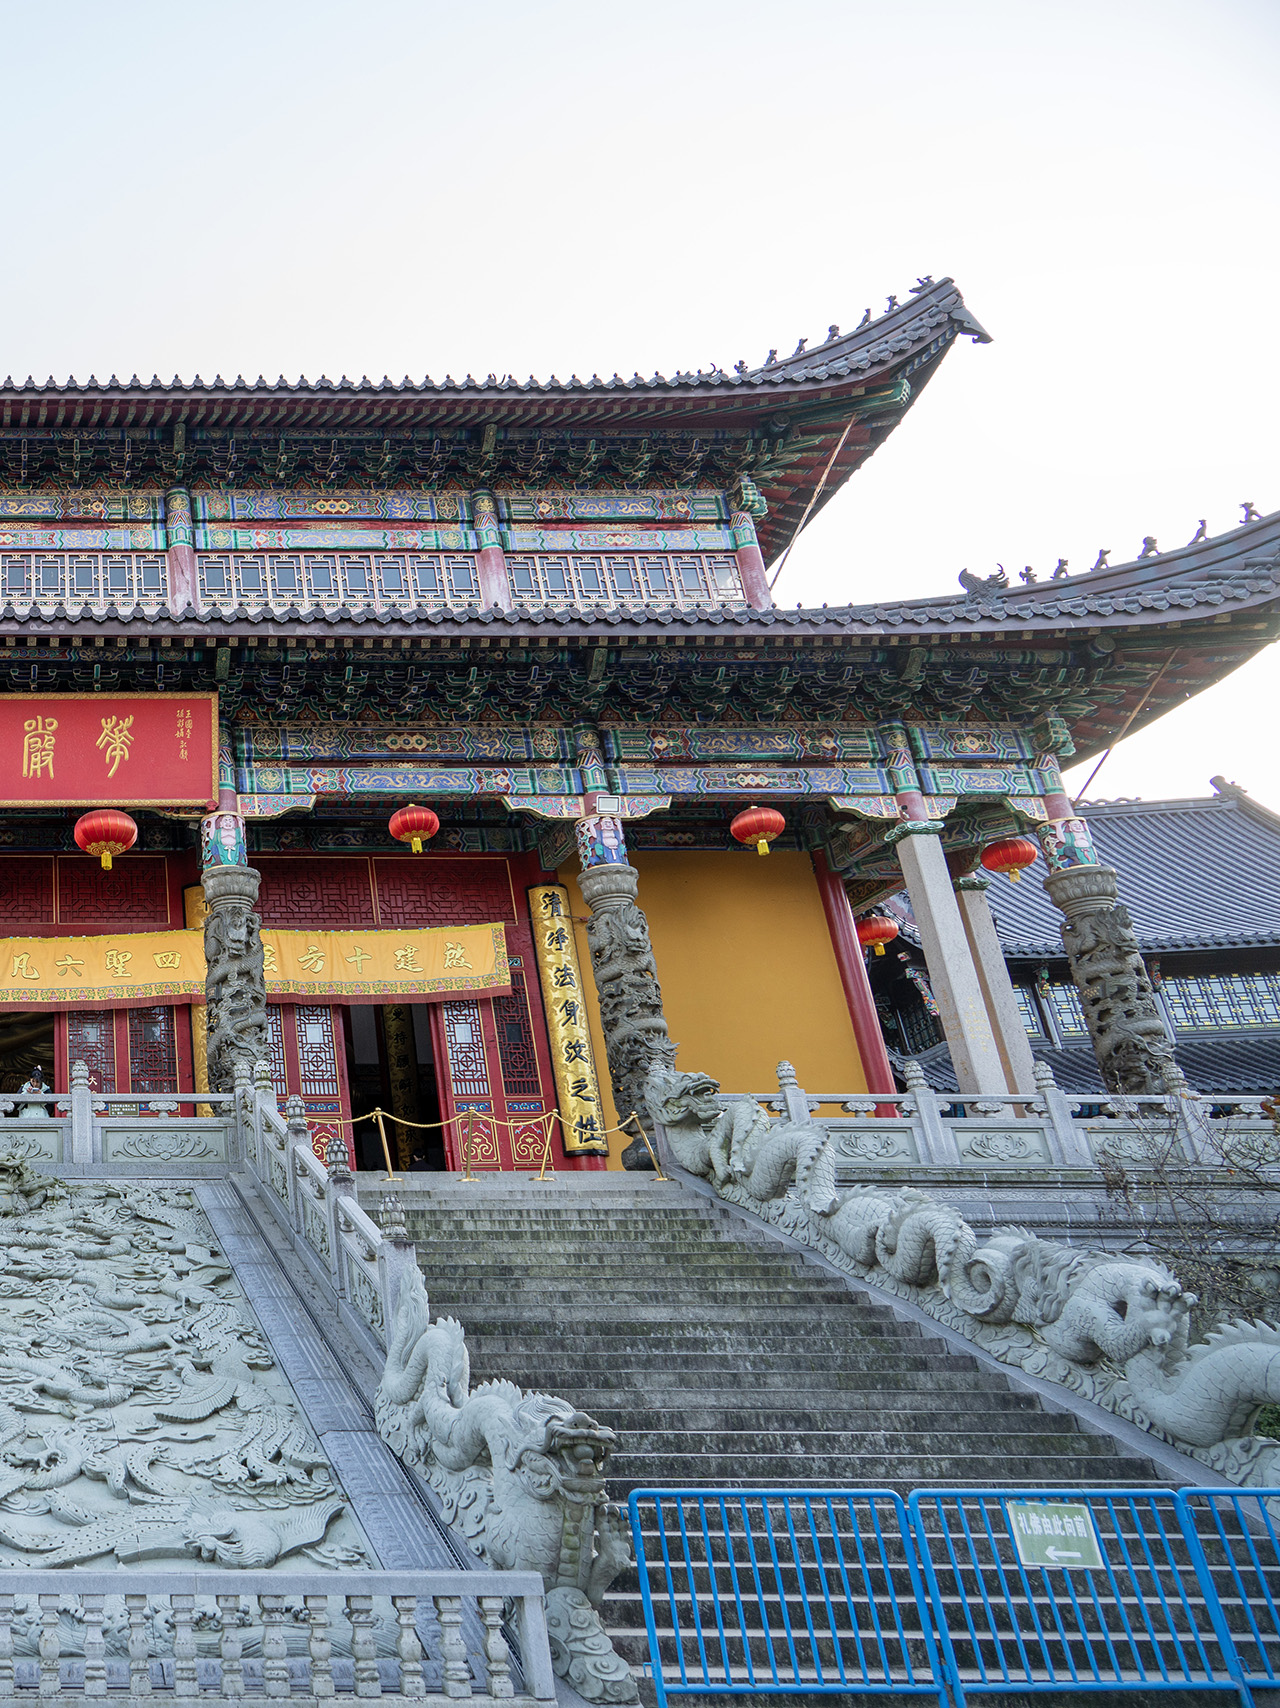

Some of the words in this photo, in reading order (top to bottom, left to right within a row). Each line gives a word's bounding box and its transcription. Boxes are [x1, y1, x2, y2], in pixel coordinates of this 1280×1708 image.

[1017, 1512, 1088, 1538] 礼佛由此向前
